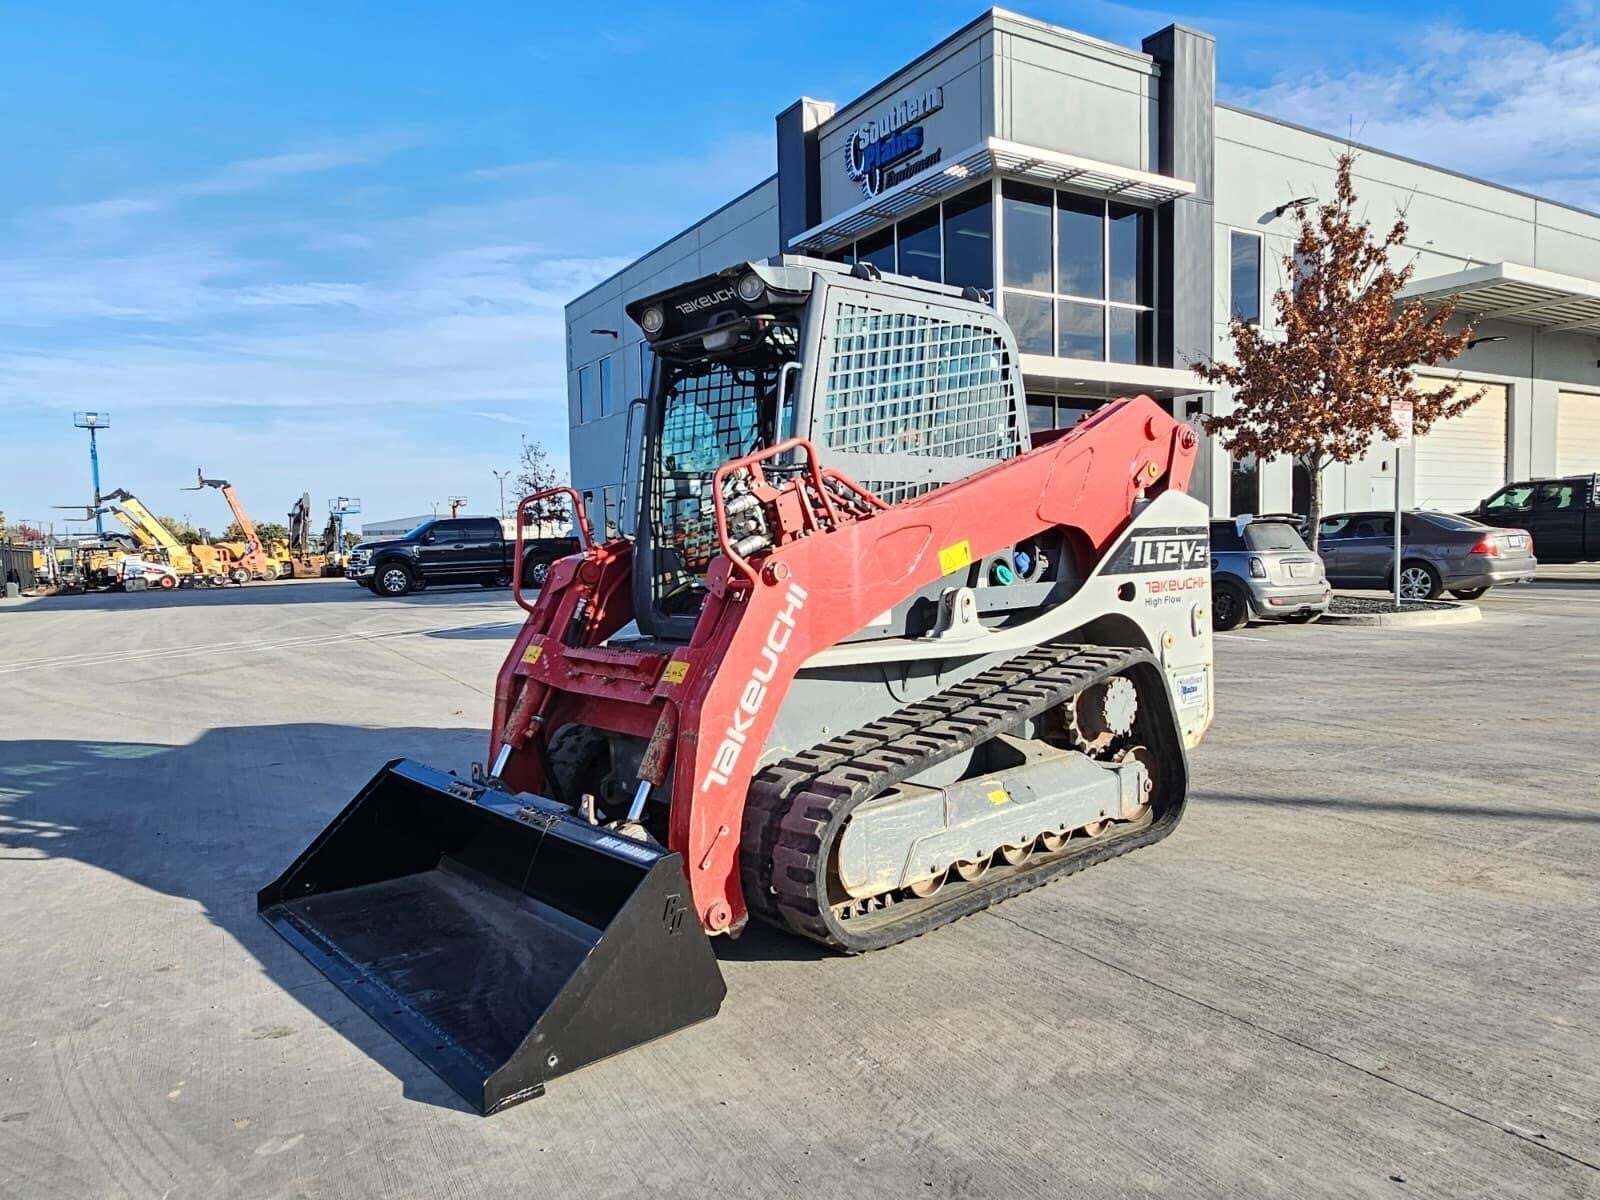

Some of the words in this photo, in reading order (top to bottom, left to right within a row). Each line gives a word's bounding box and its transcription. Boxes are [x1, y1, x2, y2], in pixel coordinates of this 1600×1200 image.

[859, 86, 943, 149] Southern
[675, 286, 738, 315] TAKEUCH
[1145, 596, 1163, 608] High
[1164, 595, 1182, 604] Flow
[701, 582, 809, 793] TAKEUCHI
